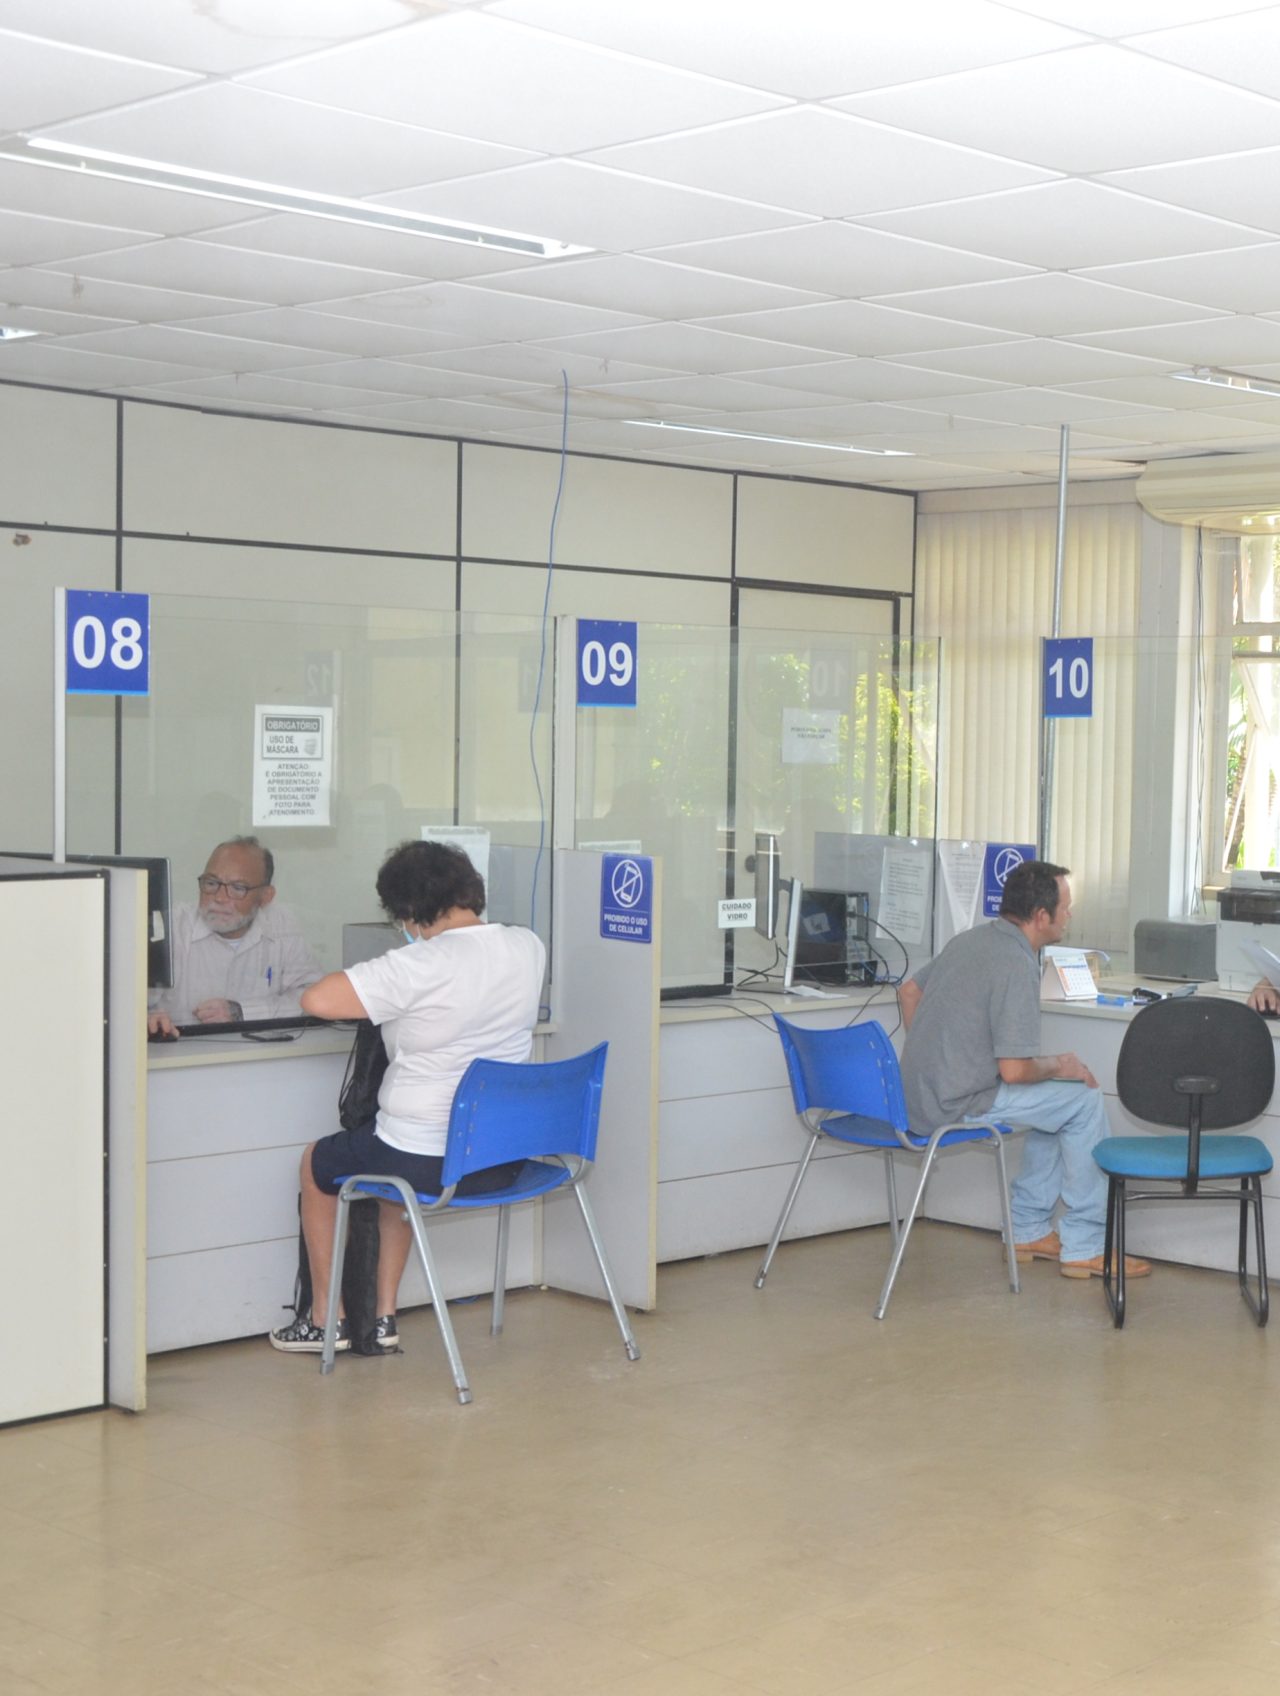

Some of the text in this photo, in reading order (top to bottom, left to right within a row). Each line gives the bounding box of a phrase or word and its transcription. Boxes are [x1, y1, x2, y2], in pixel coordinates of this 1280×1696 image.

[72, 615, 144, 671] 08
[581, 640, 633, 687] 09
[1049, 657, 1089, 699] 10
[266, 719, 319, 730] OBRIGATÓRIO
[269, 735, 295, 744] USO DE
[721, 902, 752, 910] CUIDADO
[603, 913, 648, 926] PROIBIDO O USO
[727, 912, 748, 920] VIDRO
[608, 923, 643, 936] DE CELULAR
